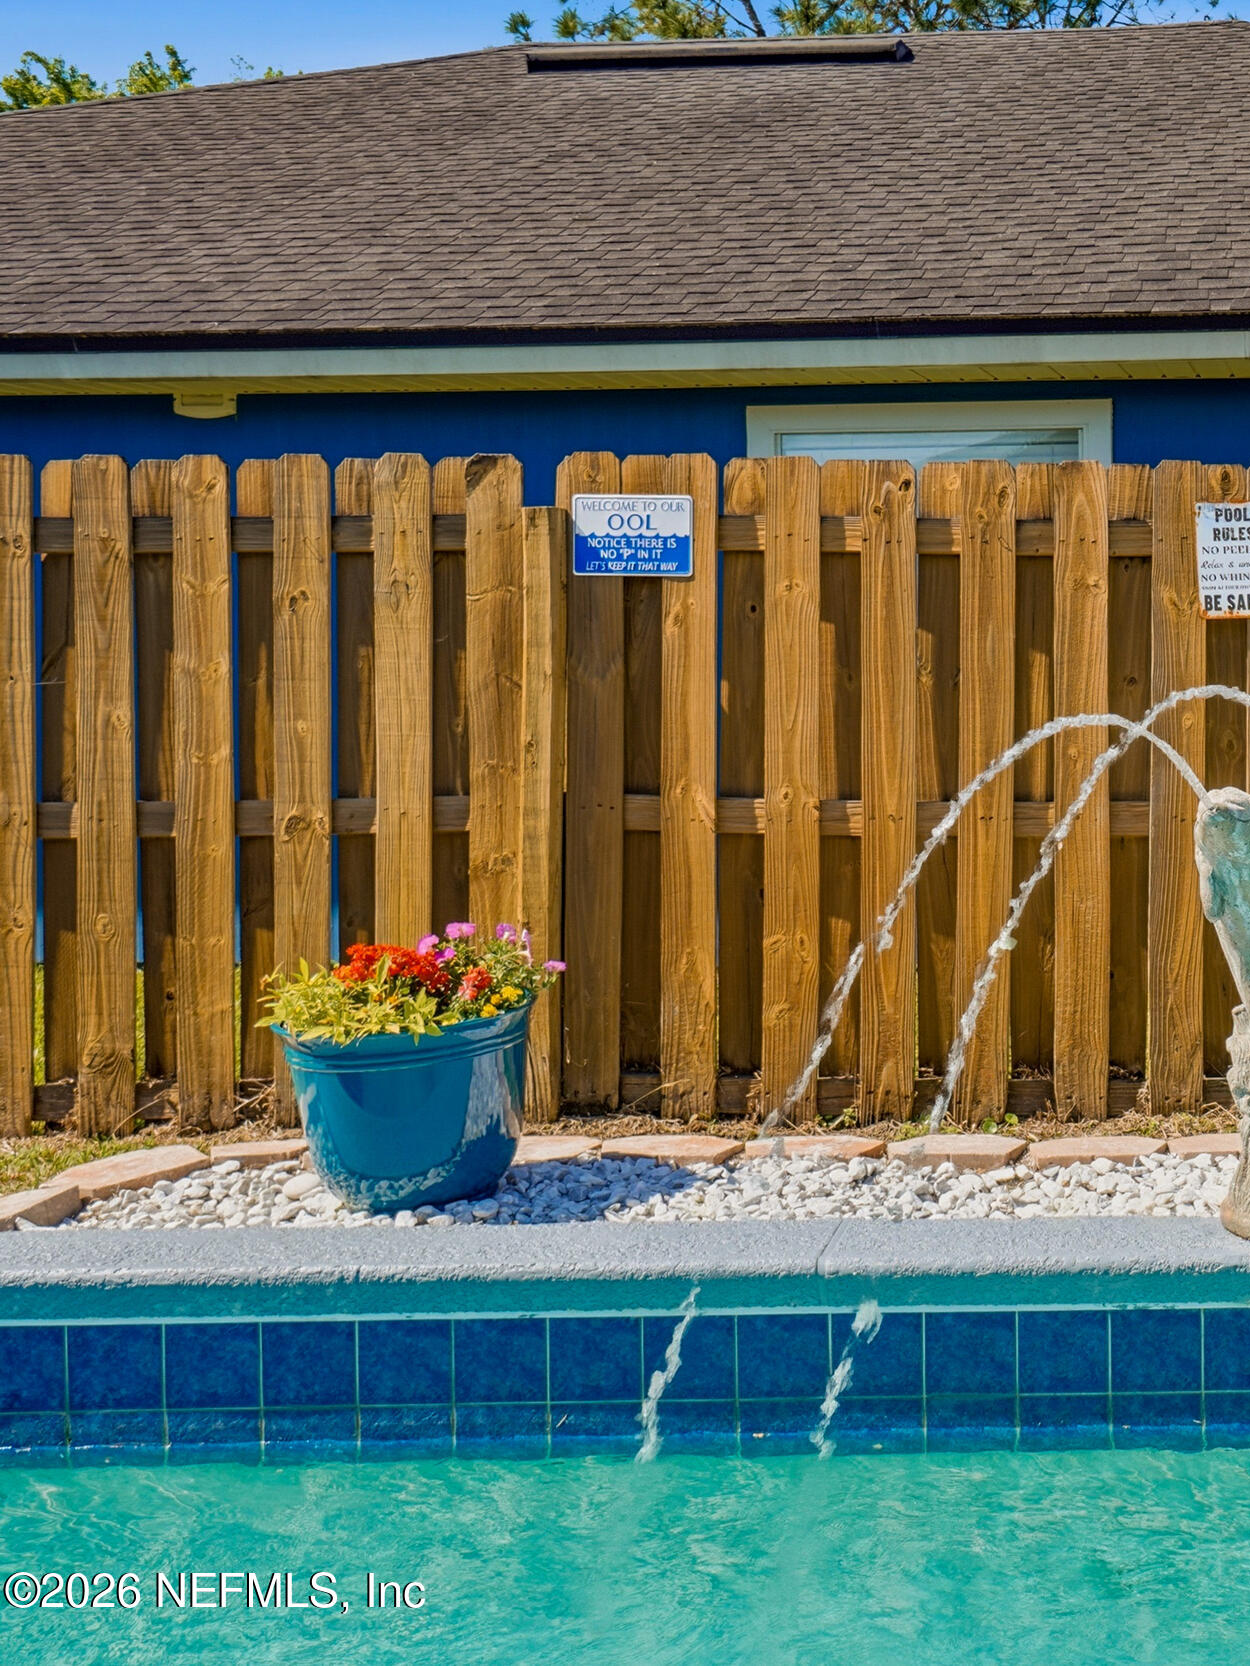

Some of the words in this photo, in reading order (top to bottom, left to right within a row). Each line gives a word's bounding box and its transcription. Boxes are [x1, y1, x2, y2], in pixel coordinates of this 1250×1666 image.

[582, 501, 638, 512] WELCOME
[643, 501, 657, 512] TO
[661, 501, 685, 512] OUR
[1215, 507, 1250, 522] POOL
[607, 513, 657, 531] OOL
[587, 538, 627, 548] NOTICE
[630, 538, 664, 548] THERE
[667, 538, 677, 548] IS
[600, 549, 617, 559] NO
[637, 549, 648, 559] IN
[652, 549, 664, 559] IT
[1202, 545, 1219, 555] NO
[586, 561, 606, 571] LET'S
[608, 561, 626, 571] KEEP
[627, 562, 636, 571] IT
[637, 562, 659, 571] THAT
[660, 562, 678, 571] WAY
[1200, 559, 1224, 569] Relax
[1201, 573, 1217, 582] NO
[1204, 594, 1222, 611] BE
